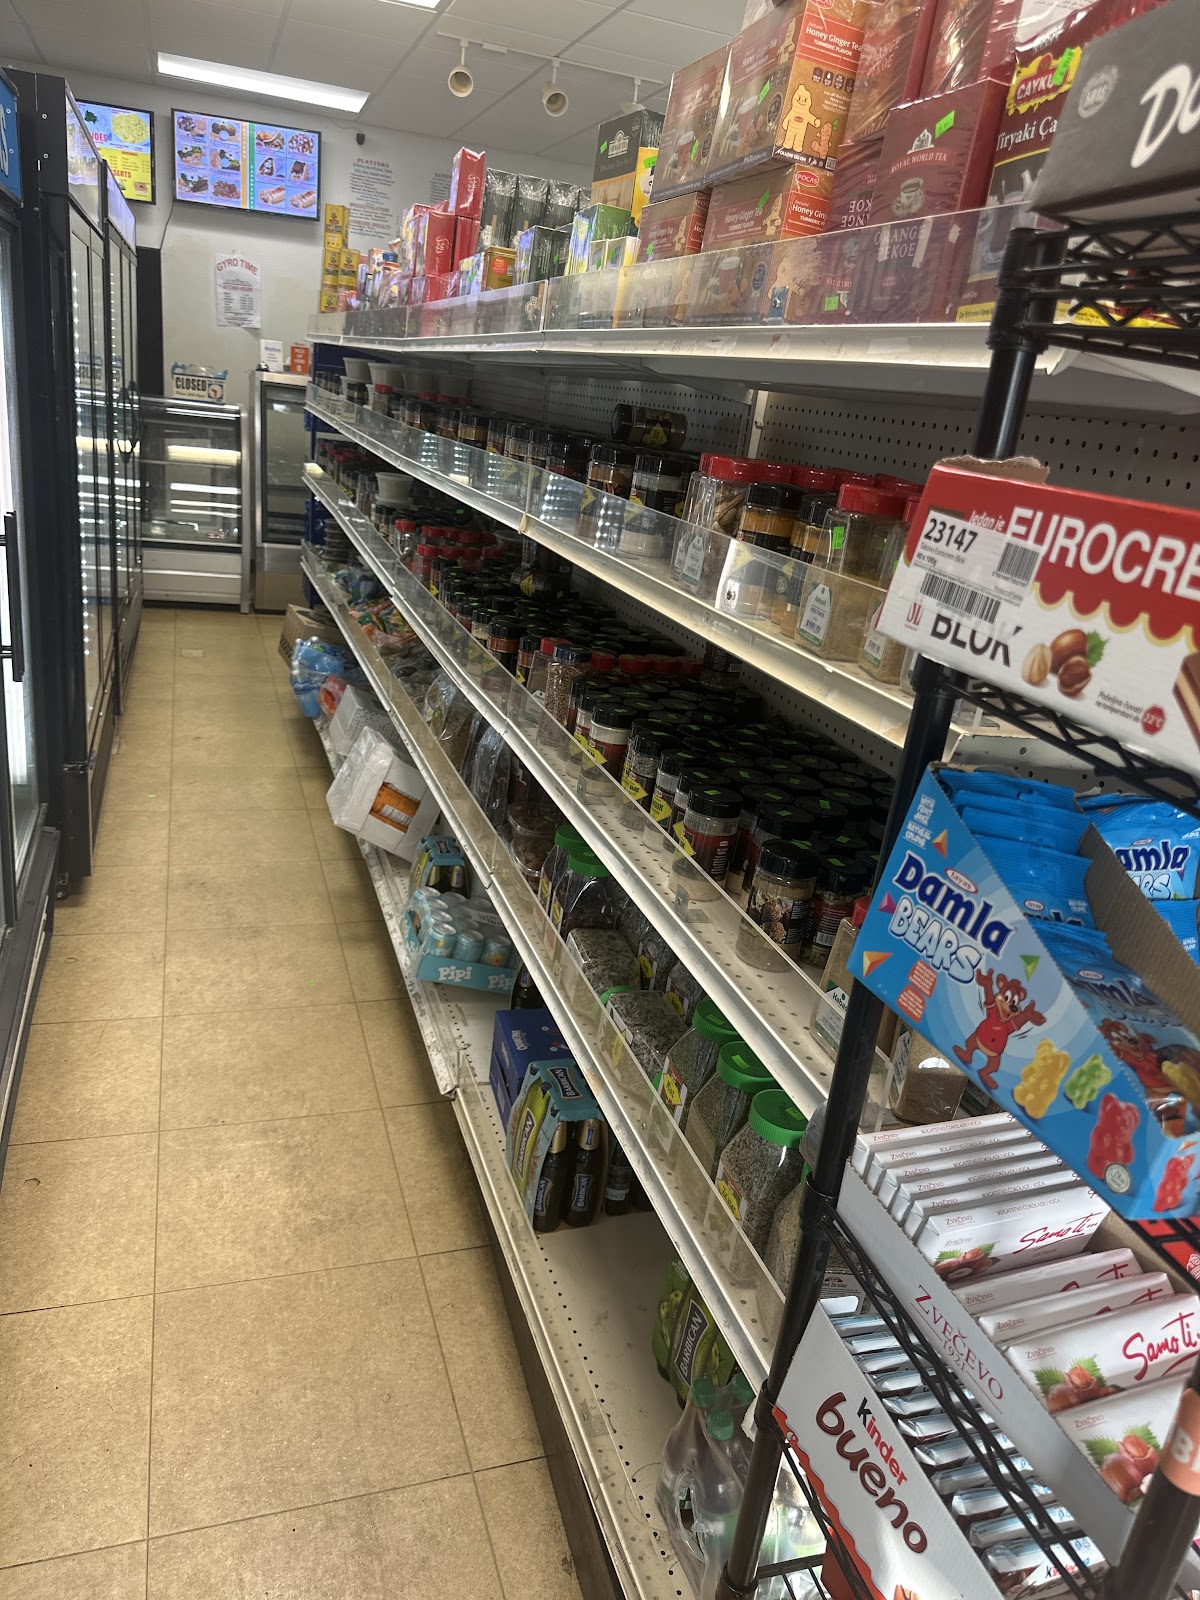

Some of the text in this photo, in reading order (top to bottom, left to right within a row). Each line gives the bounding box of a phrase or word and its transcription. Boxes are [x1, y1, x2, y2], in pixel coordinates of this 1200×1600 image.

[806, 27, 862, 51] Honey Ginger Tea
[814, 40, 835, 50] TURMERIC
[836, 47, 852, 56] FLAVOR
[357, 158, 389, 168] PLATTERS
[890, 152, 947, 173] ROYAL WORLD TEA
[797, 174, 817, 185] POCAS
[792, 204, 814, 216] Honey
[216, 258, 258, 276] GYRO TIME
[175, 377, 207, 392] CLOSED
[923, 518, 978, 554] 23147
[904, 831, 926, 848] COLOUR
[907, 822, 931, 840] NATURAL
[950, 871, 972, 891] tayas
[895, 852, 1012, 956] Damla
[890, 897, 982, 984] BEARS
[438, 965, 472, 982] Pipi
[555, 1068, 575, 1097] BARBICAN
[517, 1119, 533, 1173] BARBICAN
[872, 1133, 898, 1142] ZVEČEVO
[890, 1151, 917, 1160] ZVEČEVO
[903, 1168, 930, 1177] ZVEČEVO
[535, 1177, 547, 1211] BARBICAN
[576, 1176, 589, 1208] BARBICAN
[917, 1182, 944, 1191] ZVEČEVO
[930, 1199, 958, 1208] ZVEČEVO
[945, 1215, 973, 1226] ZVEČEVO
[1013, 1226, 1070, 1254] Samo
[964, 1293, 993, 1304] ZVEČEVO
[996, 1317, 1025, 1330] ZVEČEVO
[679, 1311, 703, 1377] BARBICAN
[915, 1284, 1004, 1400] ZVEČEVO
[943, 1340, 966, 1371] 1921
[1025, 1346, 1055, 1359] ZVEČEVO
[1122, 1332, 1179, 1381] Samo
[1073, 1414, 1105, 1428] ZVEČEVO
[857, 1397, 908, 1486] kinder
[815, 1392, 928, 1553] bueno
